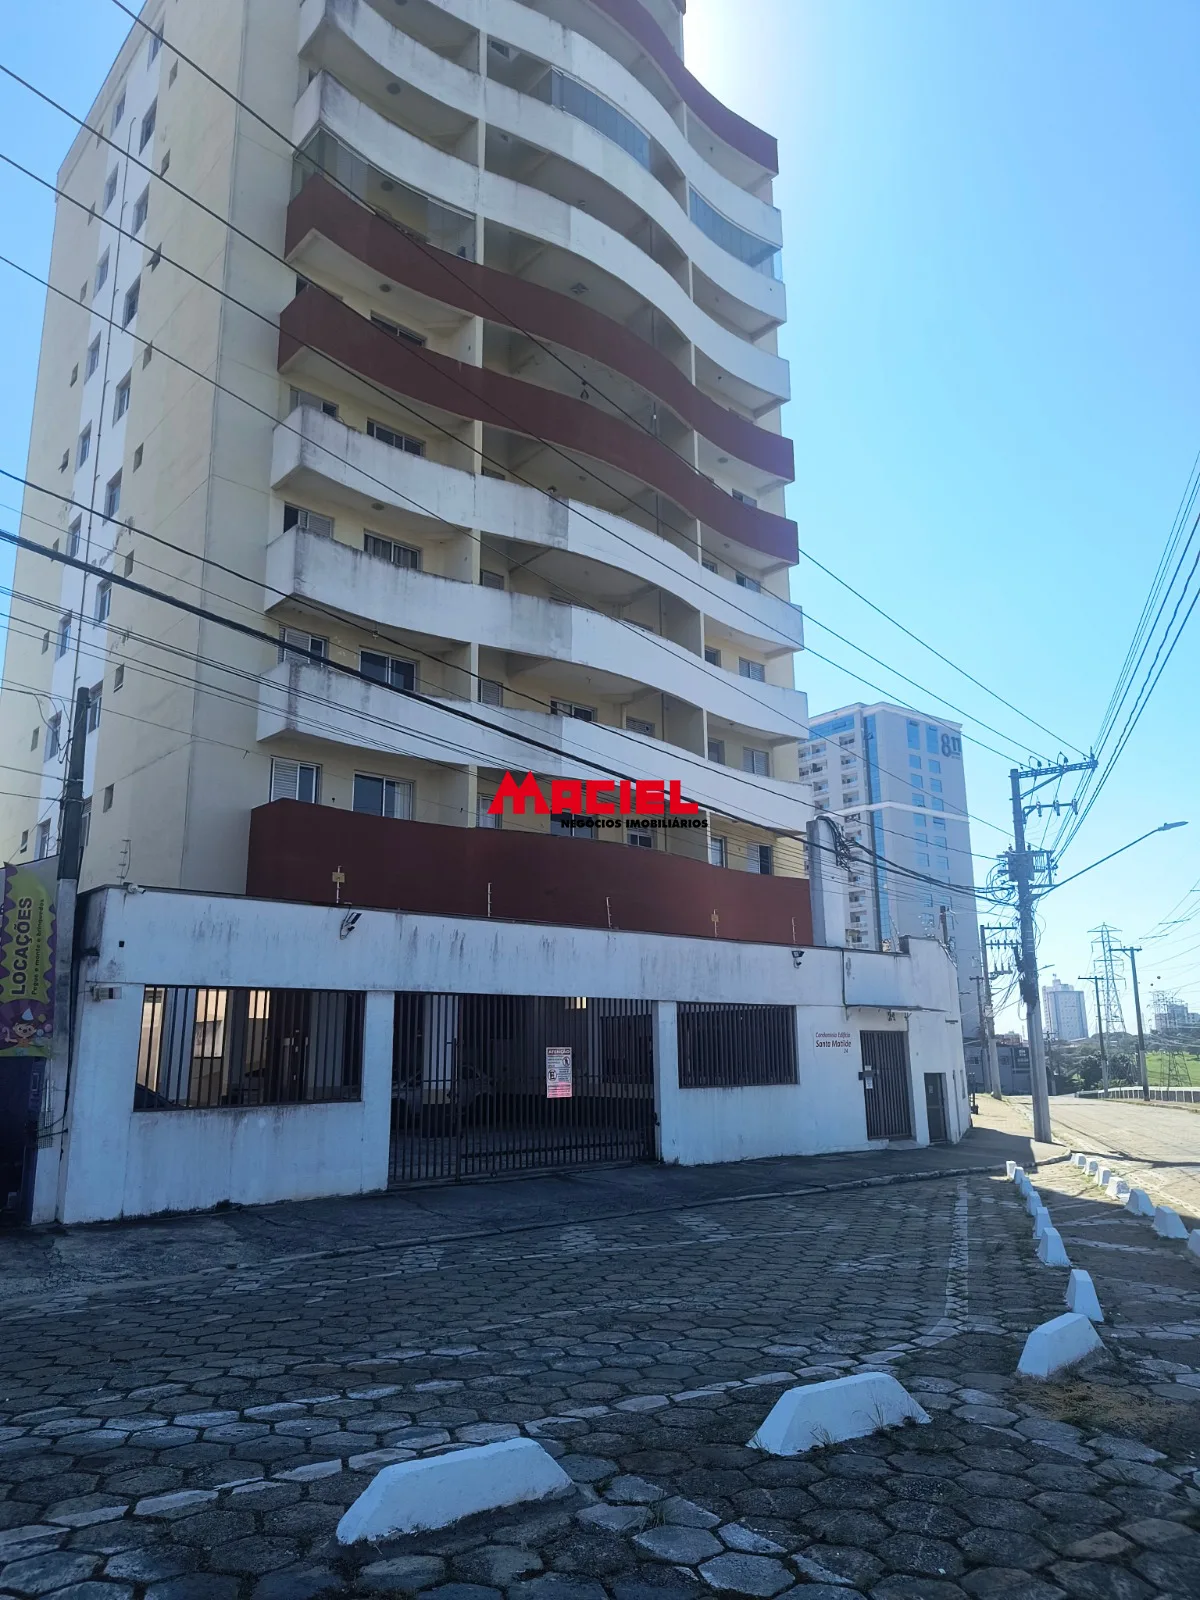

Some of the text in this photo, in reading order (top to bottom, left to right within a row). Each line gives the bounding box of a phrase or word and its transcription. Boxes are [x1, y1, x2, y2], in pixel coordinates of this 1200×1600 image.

[12, 897, 32, 995] LOCAÇÕES
[815, 1039, 852, 1048] Santa Matilde
